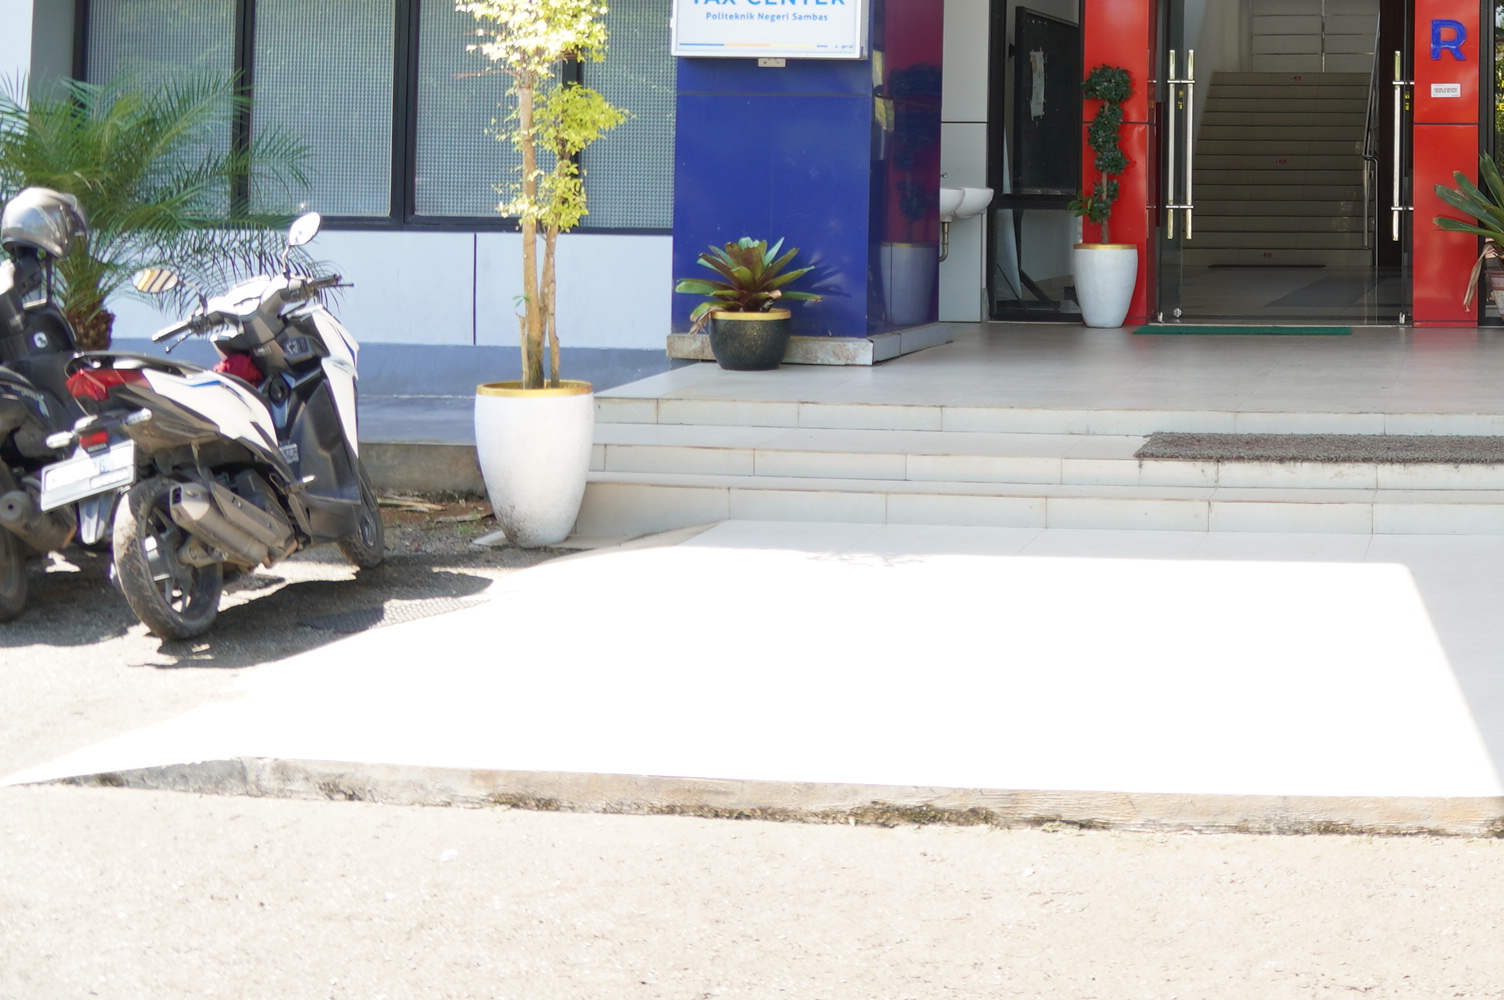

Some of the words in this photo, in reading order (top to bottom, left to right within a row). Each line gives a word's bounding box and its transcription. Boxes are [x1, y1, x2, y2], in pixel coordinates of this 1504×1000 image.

[706, 12, 755, 21] Politeknik
[757, 13, 789, 23] Negeri
[792, 13, 828, 22] Sambas
[1431, 18, 1467, 61] R
